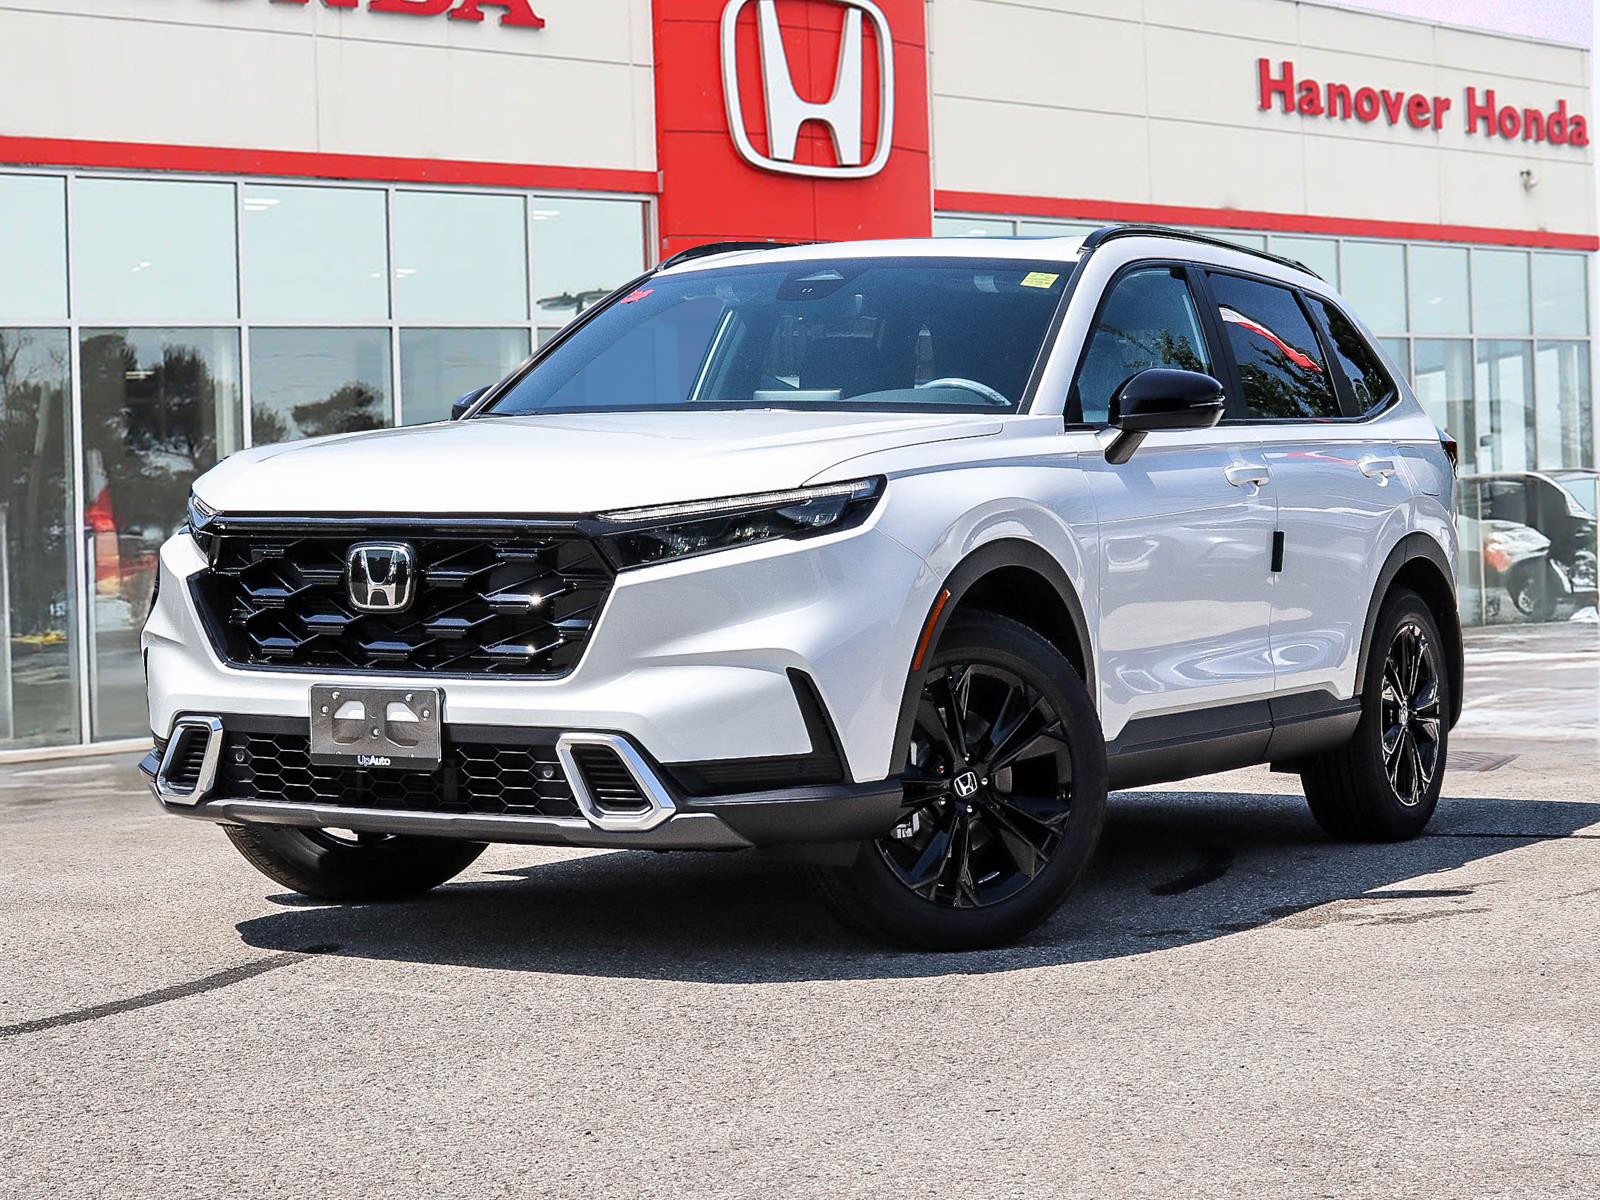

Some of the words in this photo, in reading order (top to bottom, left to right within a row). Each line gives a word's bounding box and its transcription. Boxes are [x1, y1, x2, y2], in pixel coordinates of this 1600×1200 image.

[1258, 58, 1452, 129] Hanover
[1466, 86, 1590, 147] Honda
[357, 755, 391, 767] UpAuto
